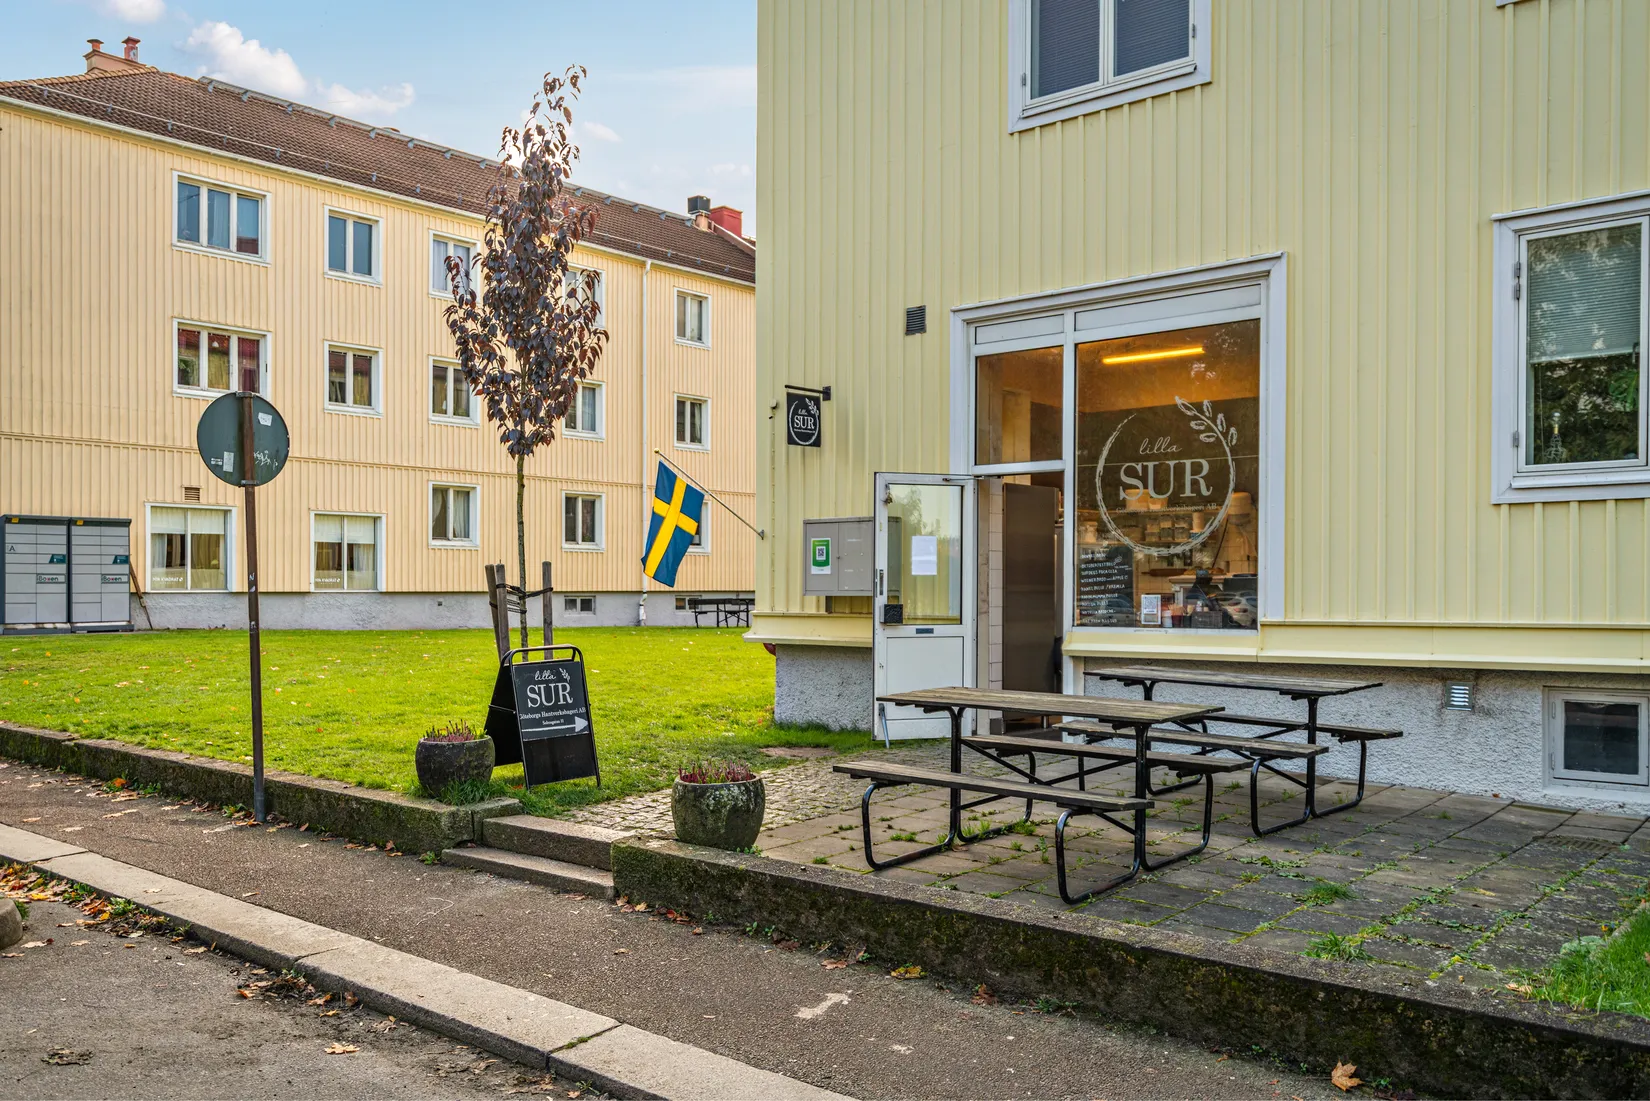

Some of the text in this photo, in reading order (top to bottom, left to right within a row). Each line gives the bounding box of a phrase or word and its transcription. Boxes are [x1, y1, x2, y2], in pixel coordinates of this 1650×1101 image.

[794, 415, 814, 429] SUR
[1139, 436, 1182, 455] lilla
[1119, 458, 1213, 501] SUR
[535, 670, 556, 681] lilla
[527, 683, 573, 707] SUR
